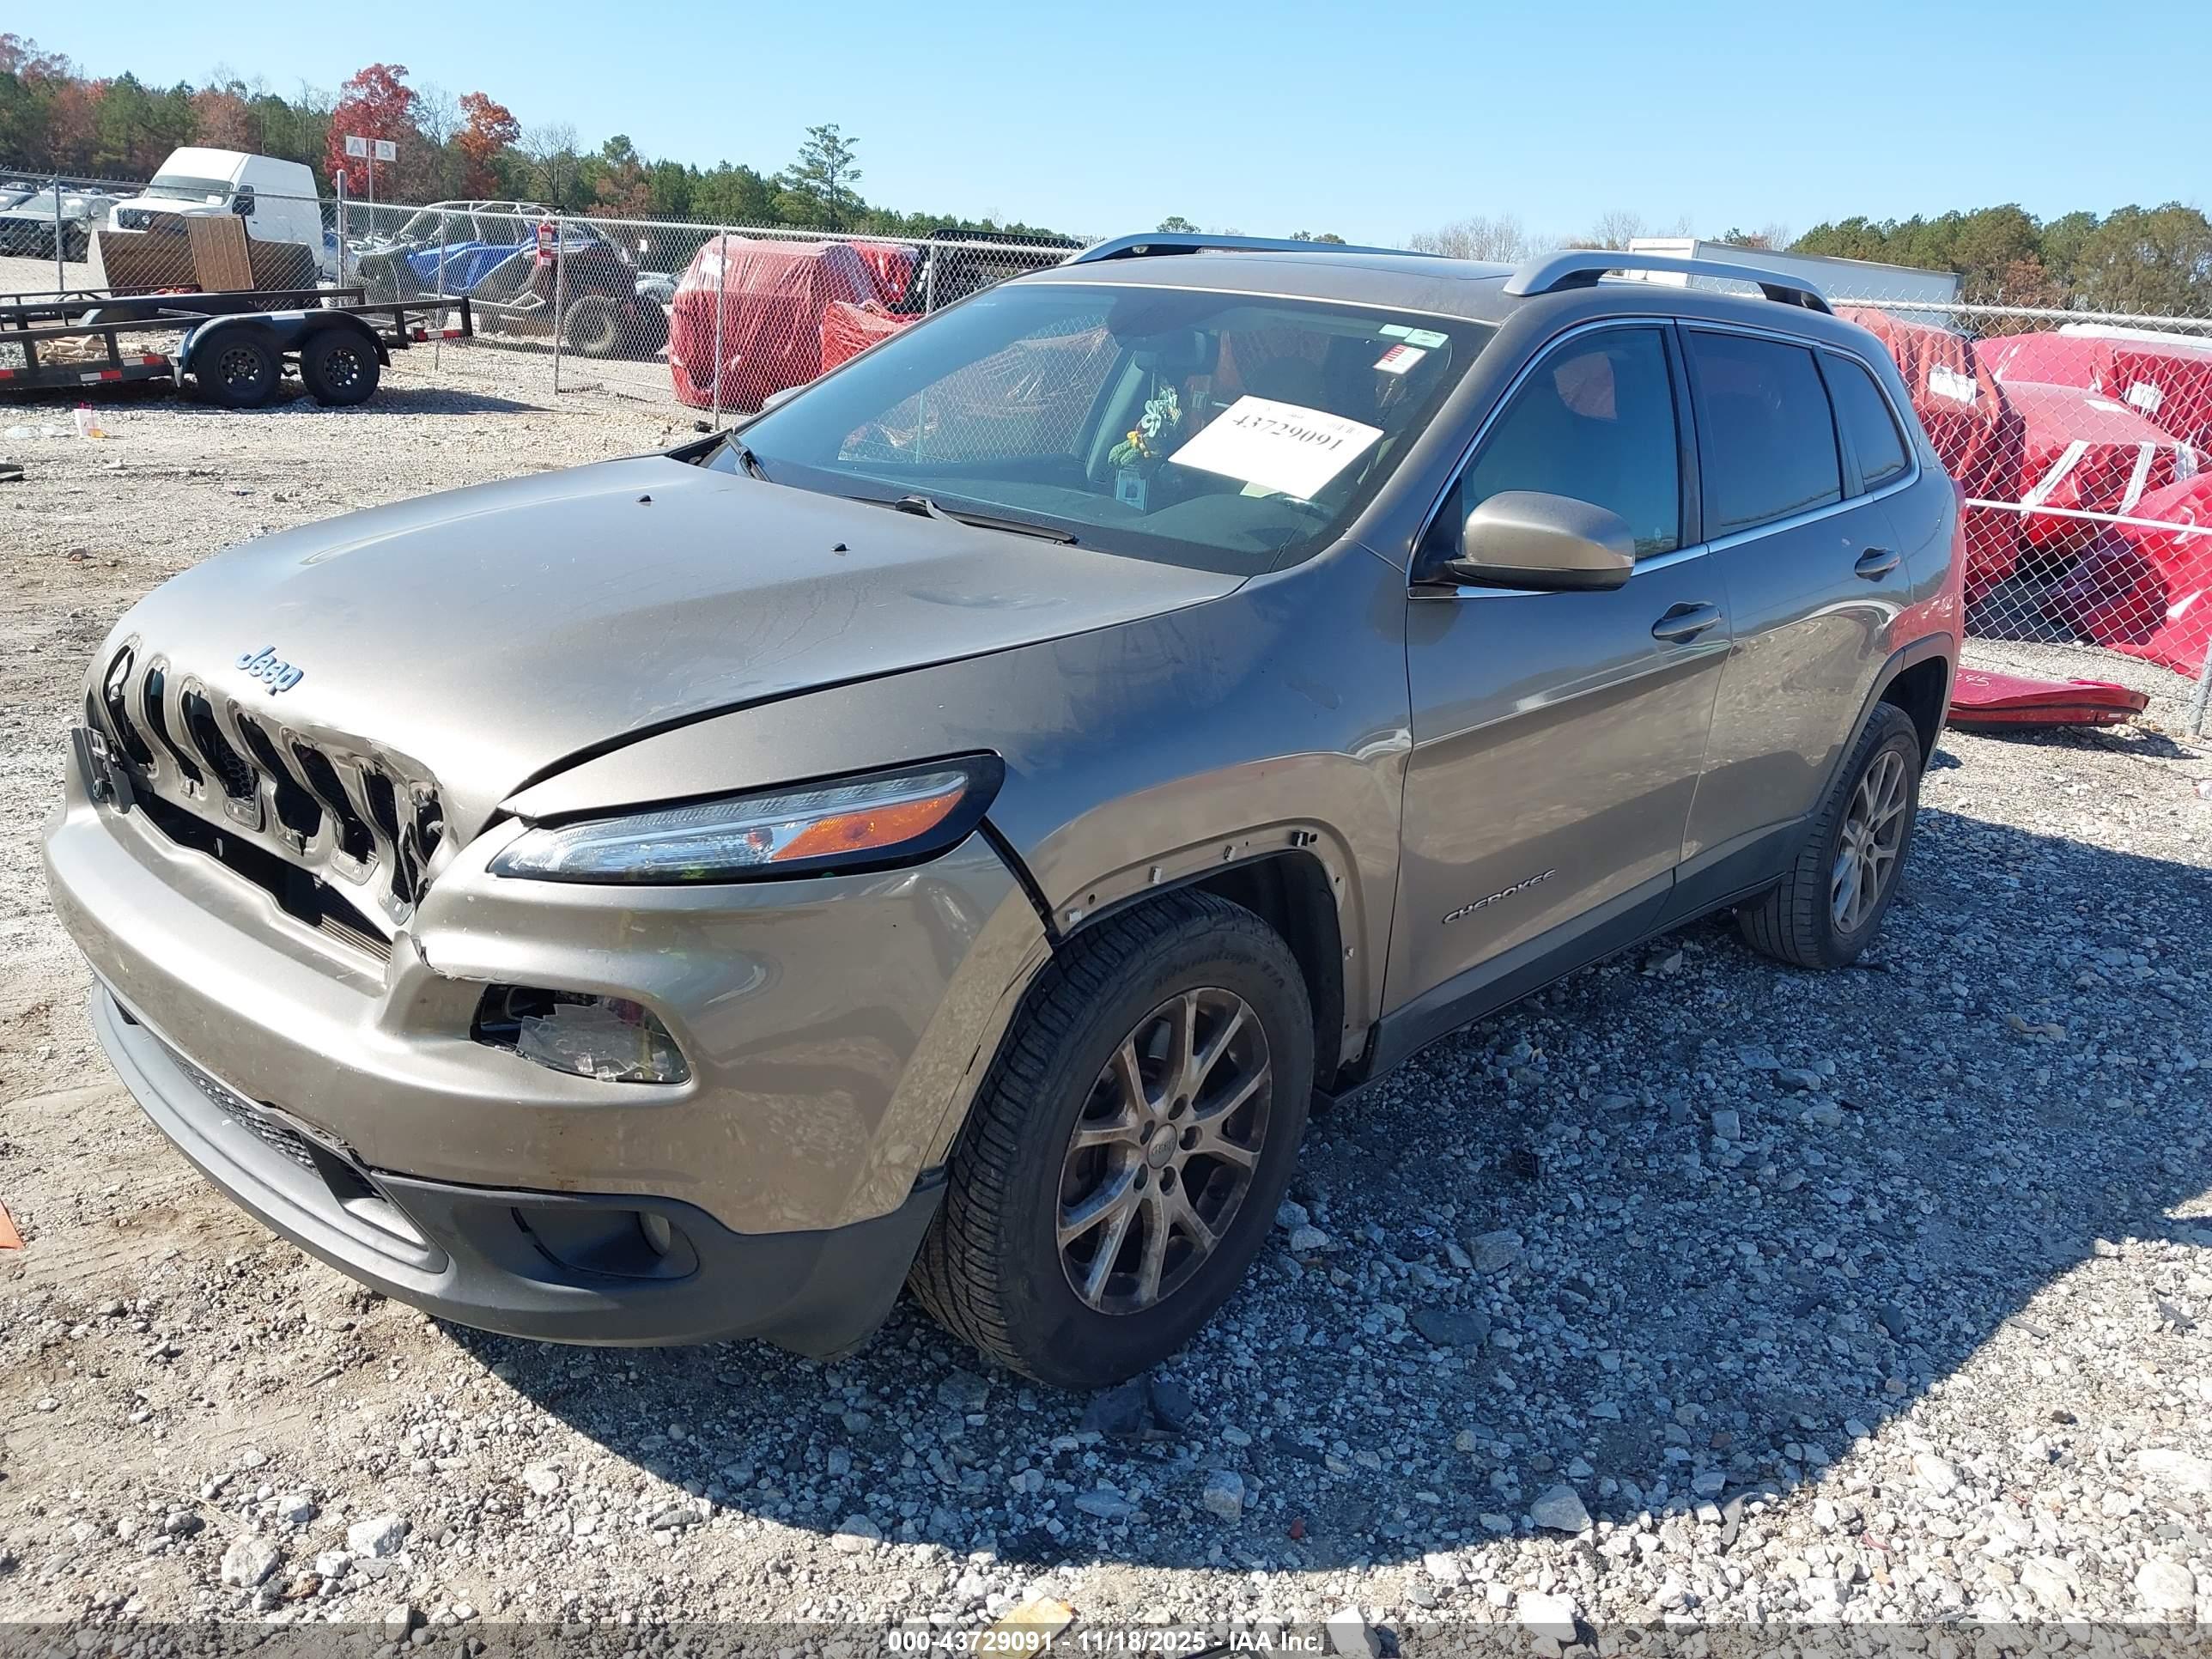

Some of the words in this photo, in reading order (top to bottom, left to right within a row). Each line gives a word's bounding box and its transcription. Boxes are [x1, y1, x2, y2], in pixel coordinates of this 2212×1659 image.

[349, 139, 363, 155] A
[380, 143, 392, 158] B
[1232, 414, 1345, 452] 43729091
[234, 645, 304, 696] Jeep
[1443, 868, 1556, 924] CHEROKEE
